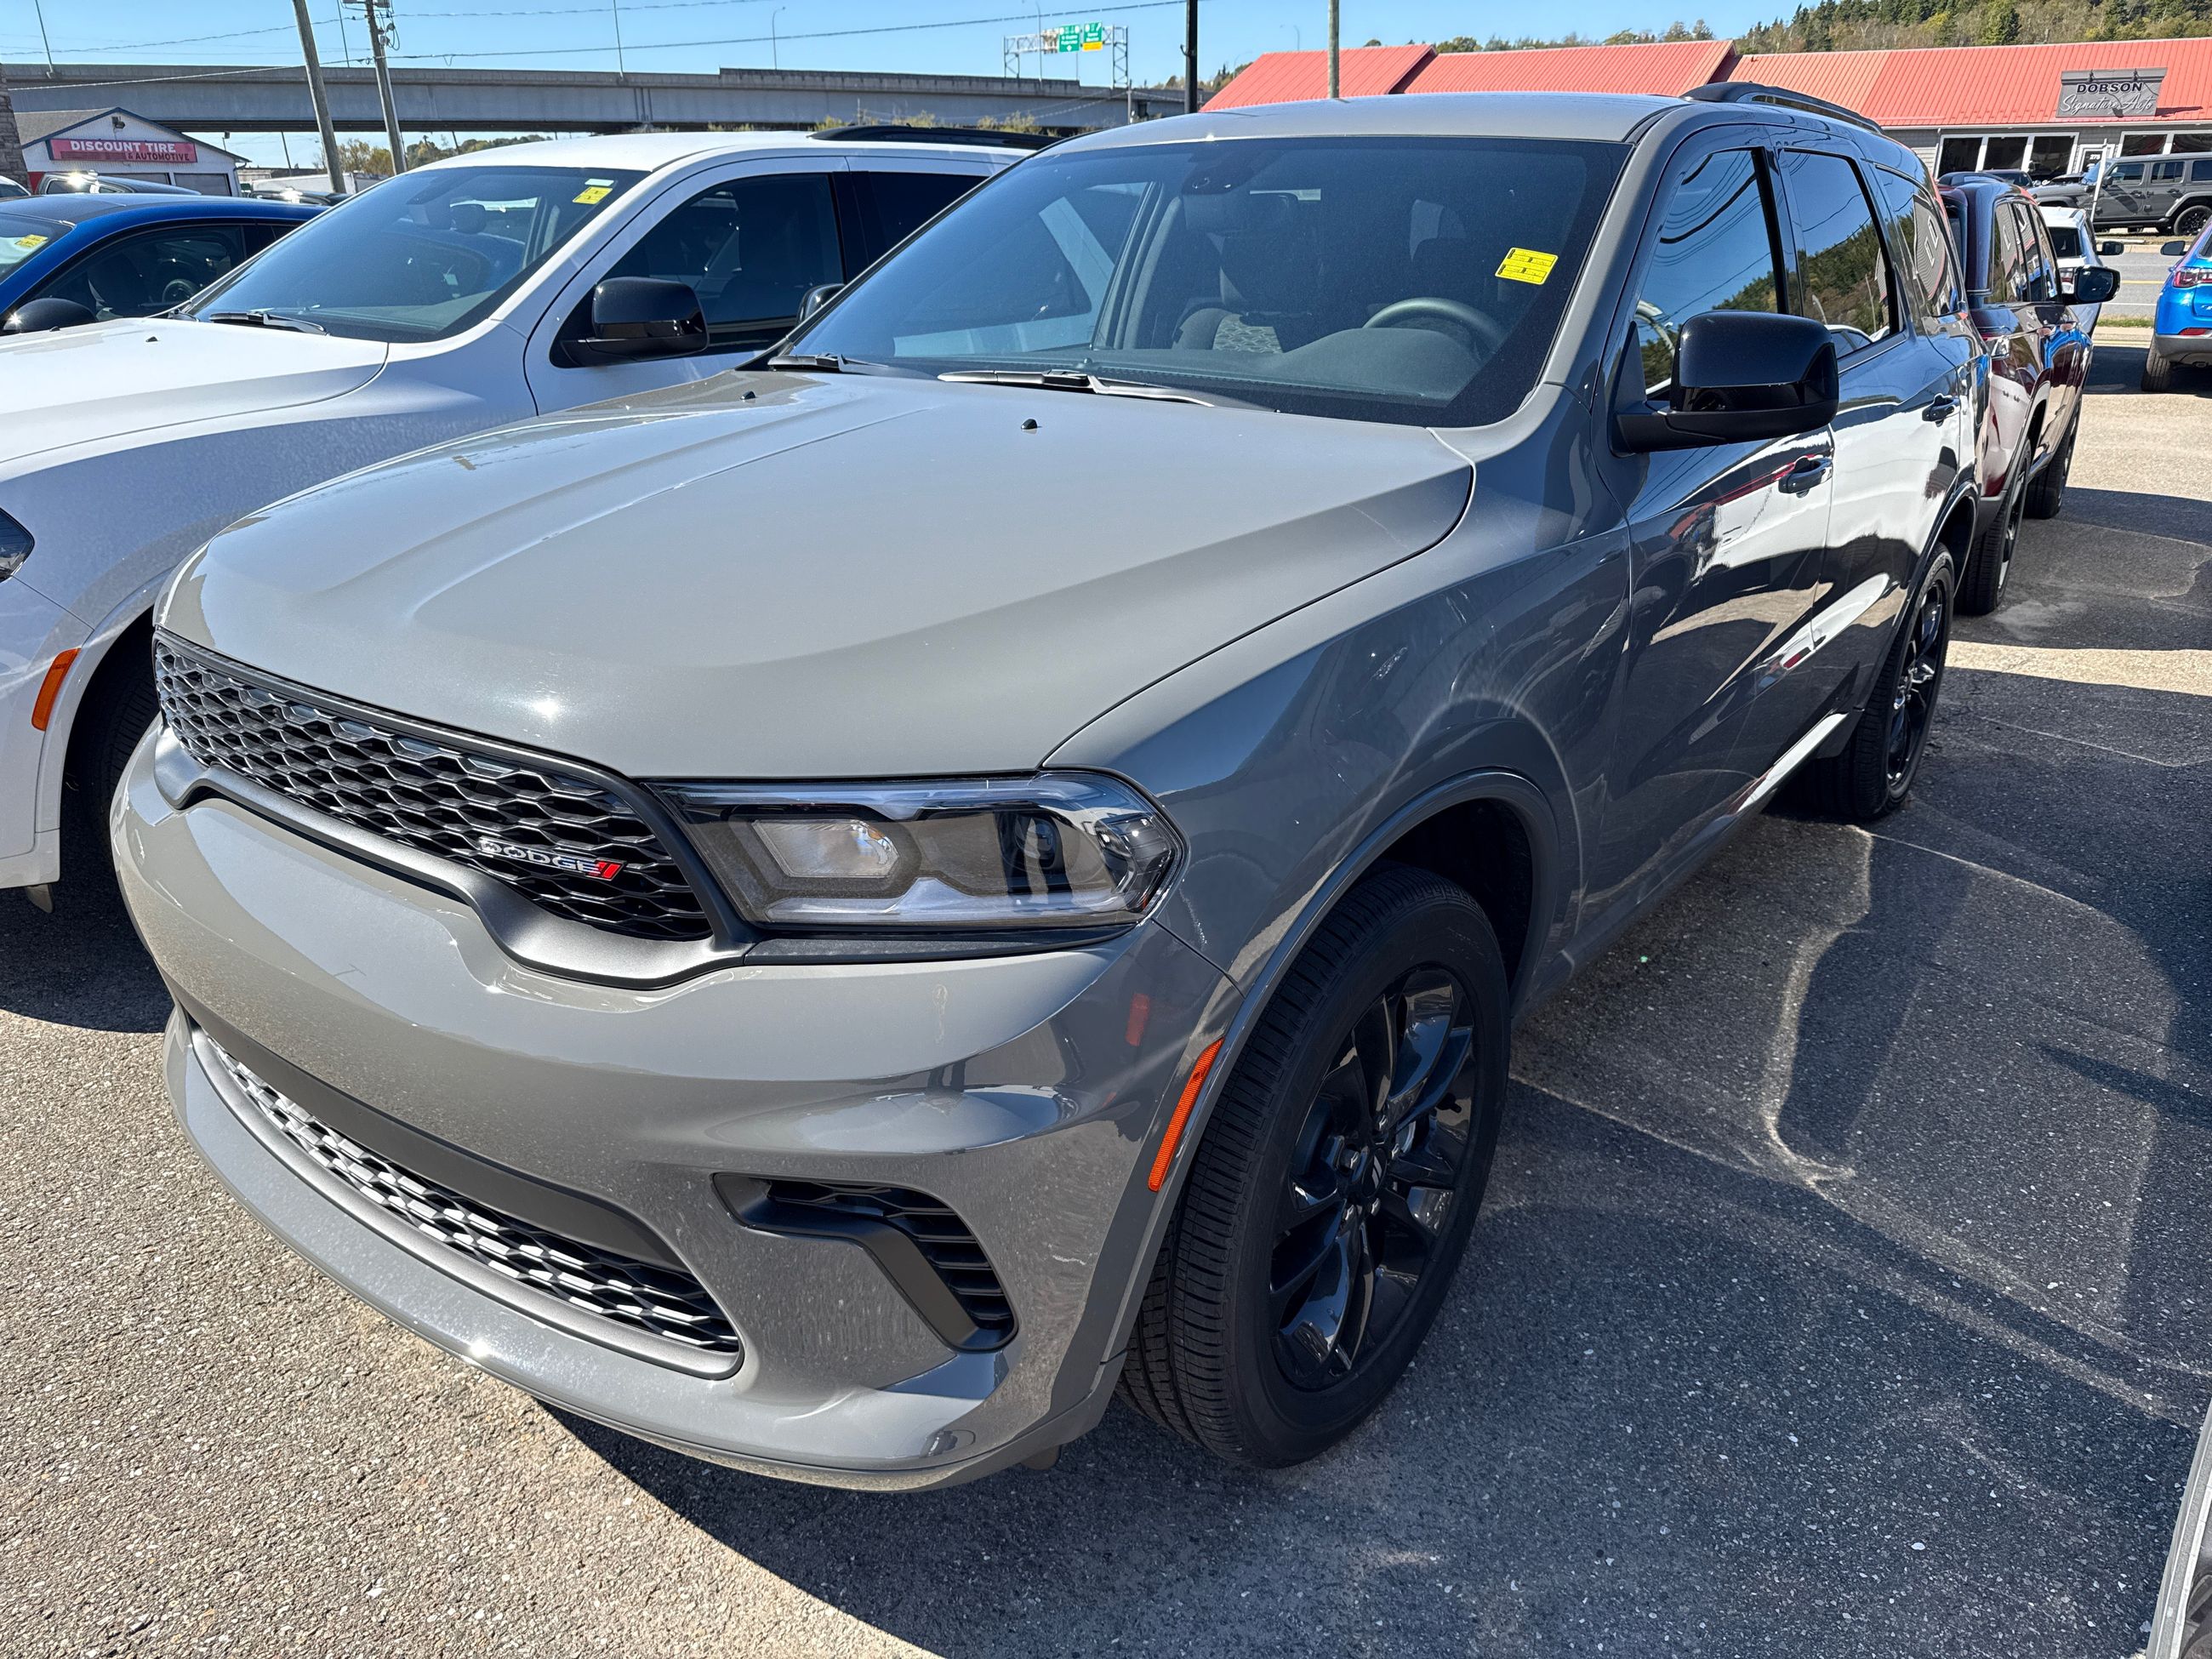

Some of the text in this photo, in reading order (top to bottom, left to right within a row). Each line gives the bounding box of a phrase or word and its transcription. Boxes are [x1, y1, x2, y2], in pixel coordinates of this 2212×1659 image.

[2076, 82, 2143, 94] DOBSON
[2060, 93, 2157, 116] Signature Auto
[71, 140, 176, 153] DISCOUNT TIRE
[135, 152, 189, 161] AUTOMOTIVE
[480, 840, 601, 875] DODGE
